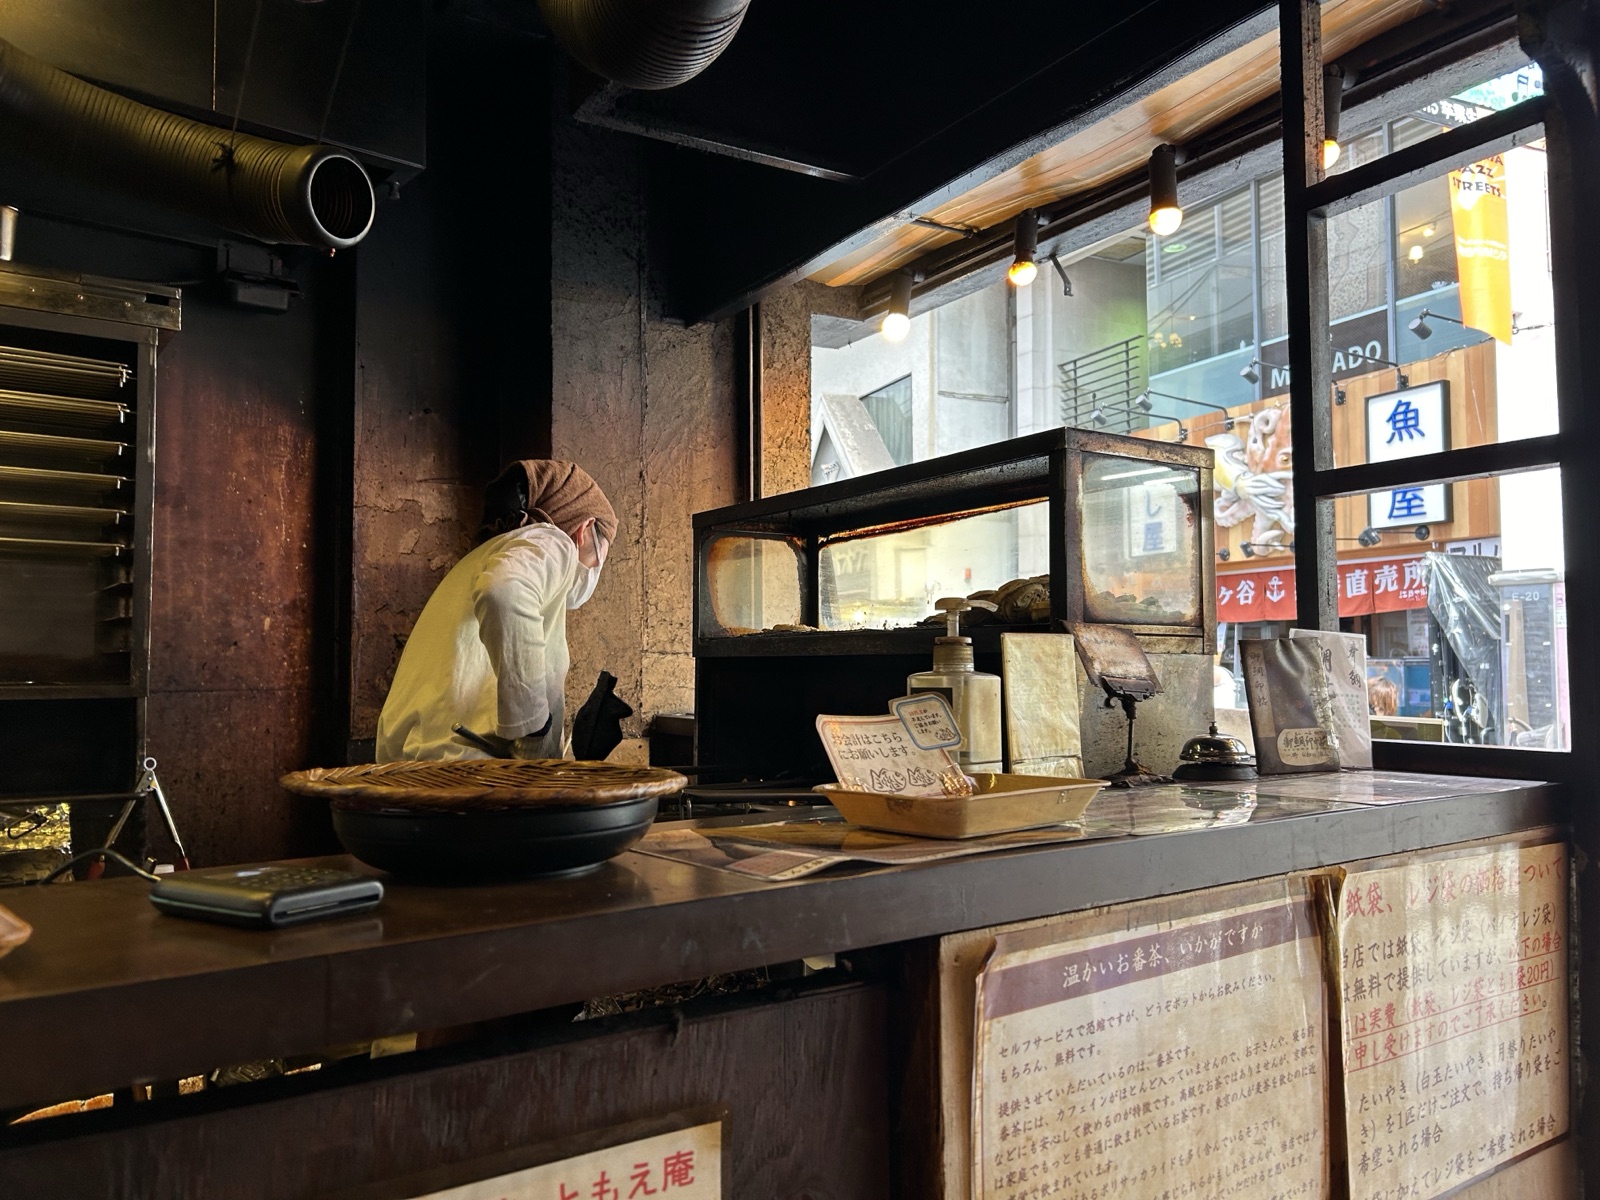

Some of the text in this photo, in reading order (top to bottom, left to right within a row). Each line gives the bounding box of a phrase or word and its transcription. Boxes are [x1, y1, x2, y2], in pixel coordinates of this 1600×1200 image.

[1452, 177, 1502, 198] STREETS
[1458, 164, 1494, 178] AZZ
[1270, 340, 1382, 390] MADO
[1336, 560, 1428, 599] 直売所
[832, 731, 903, 747] お会計はこちら
[838, 744, 917, 761] にお願いします。
[1346, 856, 1564, 918] 紙袋、レジ袋の価格について
[1061, 923, 1264, 989] 温かいお番茶、いかがですか
[999, 973, 1277, 1059] セルフサービスで恐縮ですが、どうぞポットからお飲みください。
[1346, 994, 1548, 1072] 申し受けますのでご了承ください。
[998, 1045, 1196, 1118] 提供させていただいているのは、番茶です。
[1001, 1043, 1102, 1084] もちろん、無料です。
[1358, 1122, 1444, 1177] 希望される場合
[1364, 1113, 1557, 1200] に加えてレジ袋をご希望される場合
[559, 1150, 695, 1200] ともえ庵
